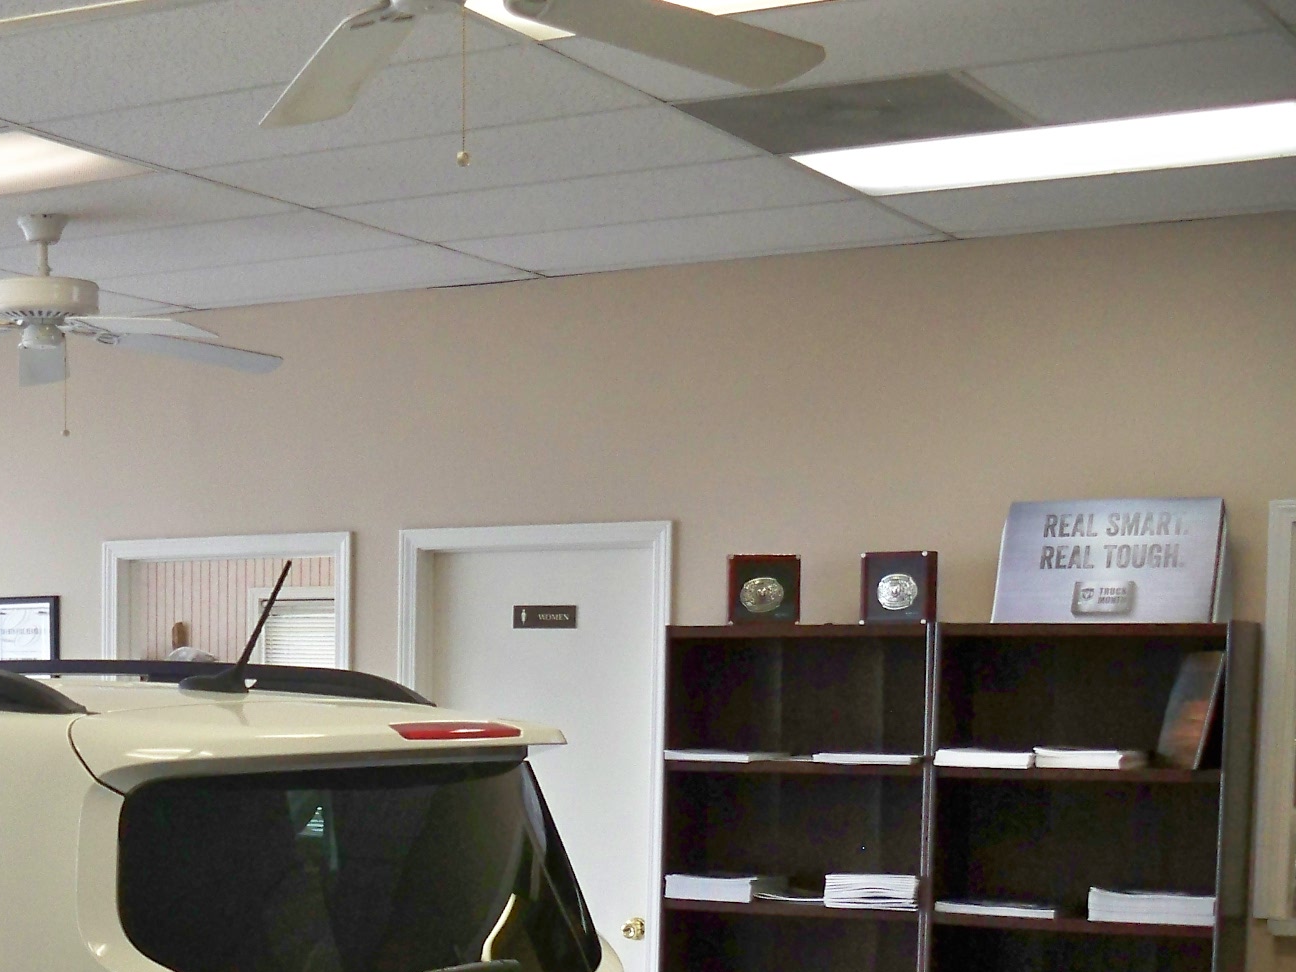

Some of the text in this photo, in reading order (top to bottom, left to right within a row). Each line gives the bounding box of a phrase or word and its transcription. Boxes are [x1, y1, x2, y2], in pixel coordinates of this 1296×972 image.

[1043, 511, 1190, 538] REAL SMART.
[1039, 543, 1186, 570] REAL TOUGH.
[1099, 587, 1127, 596] TRUCK
[538, 613, 570, 621] WOMEN
